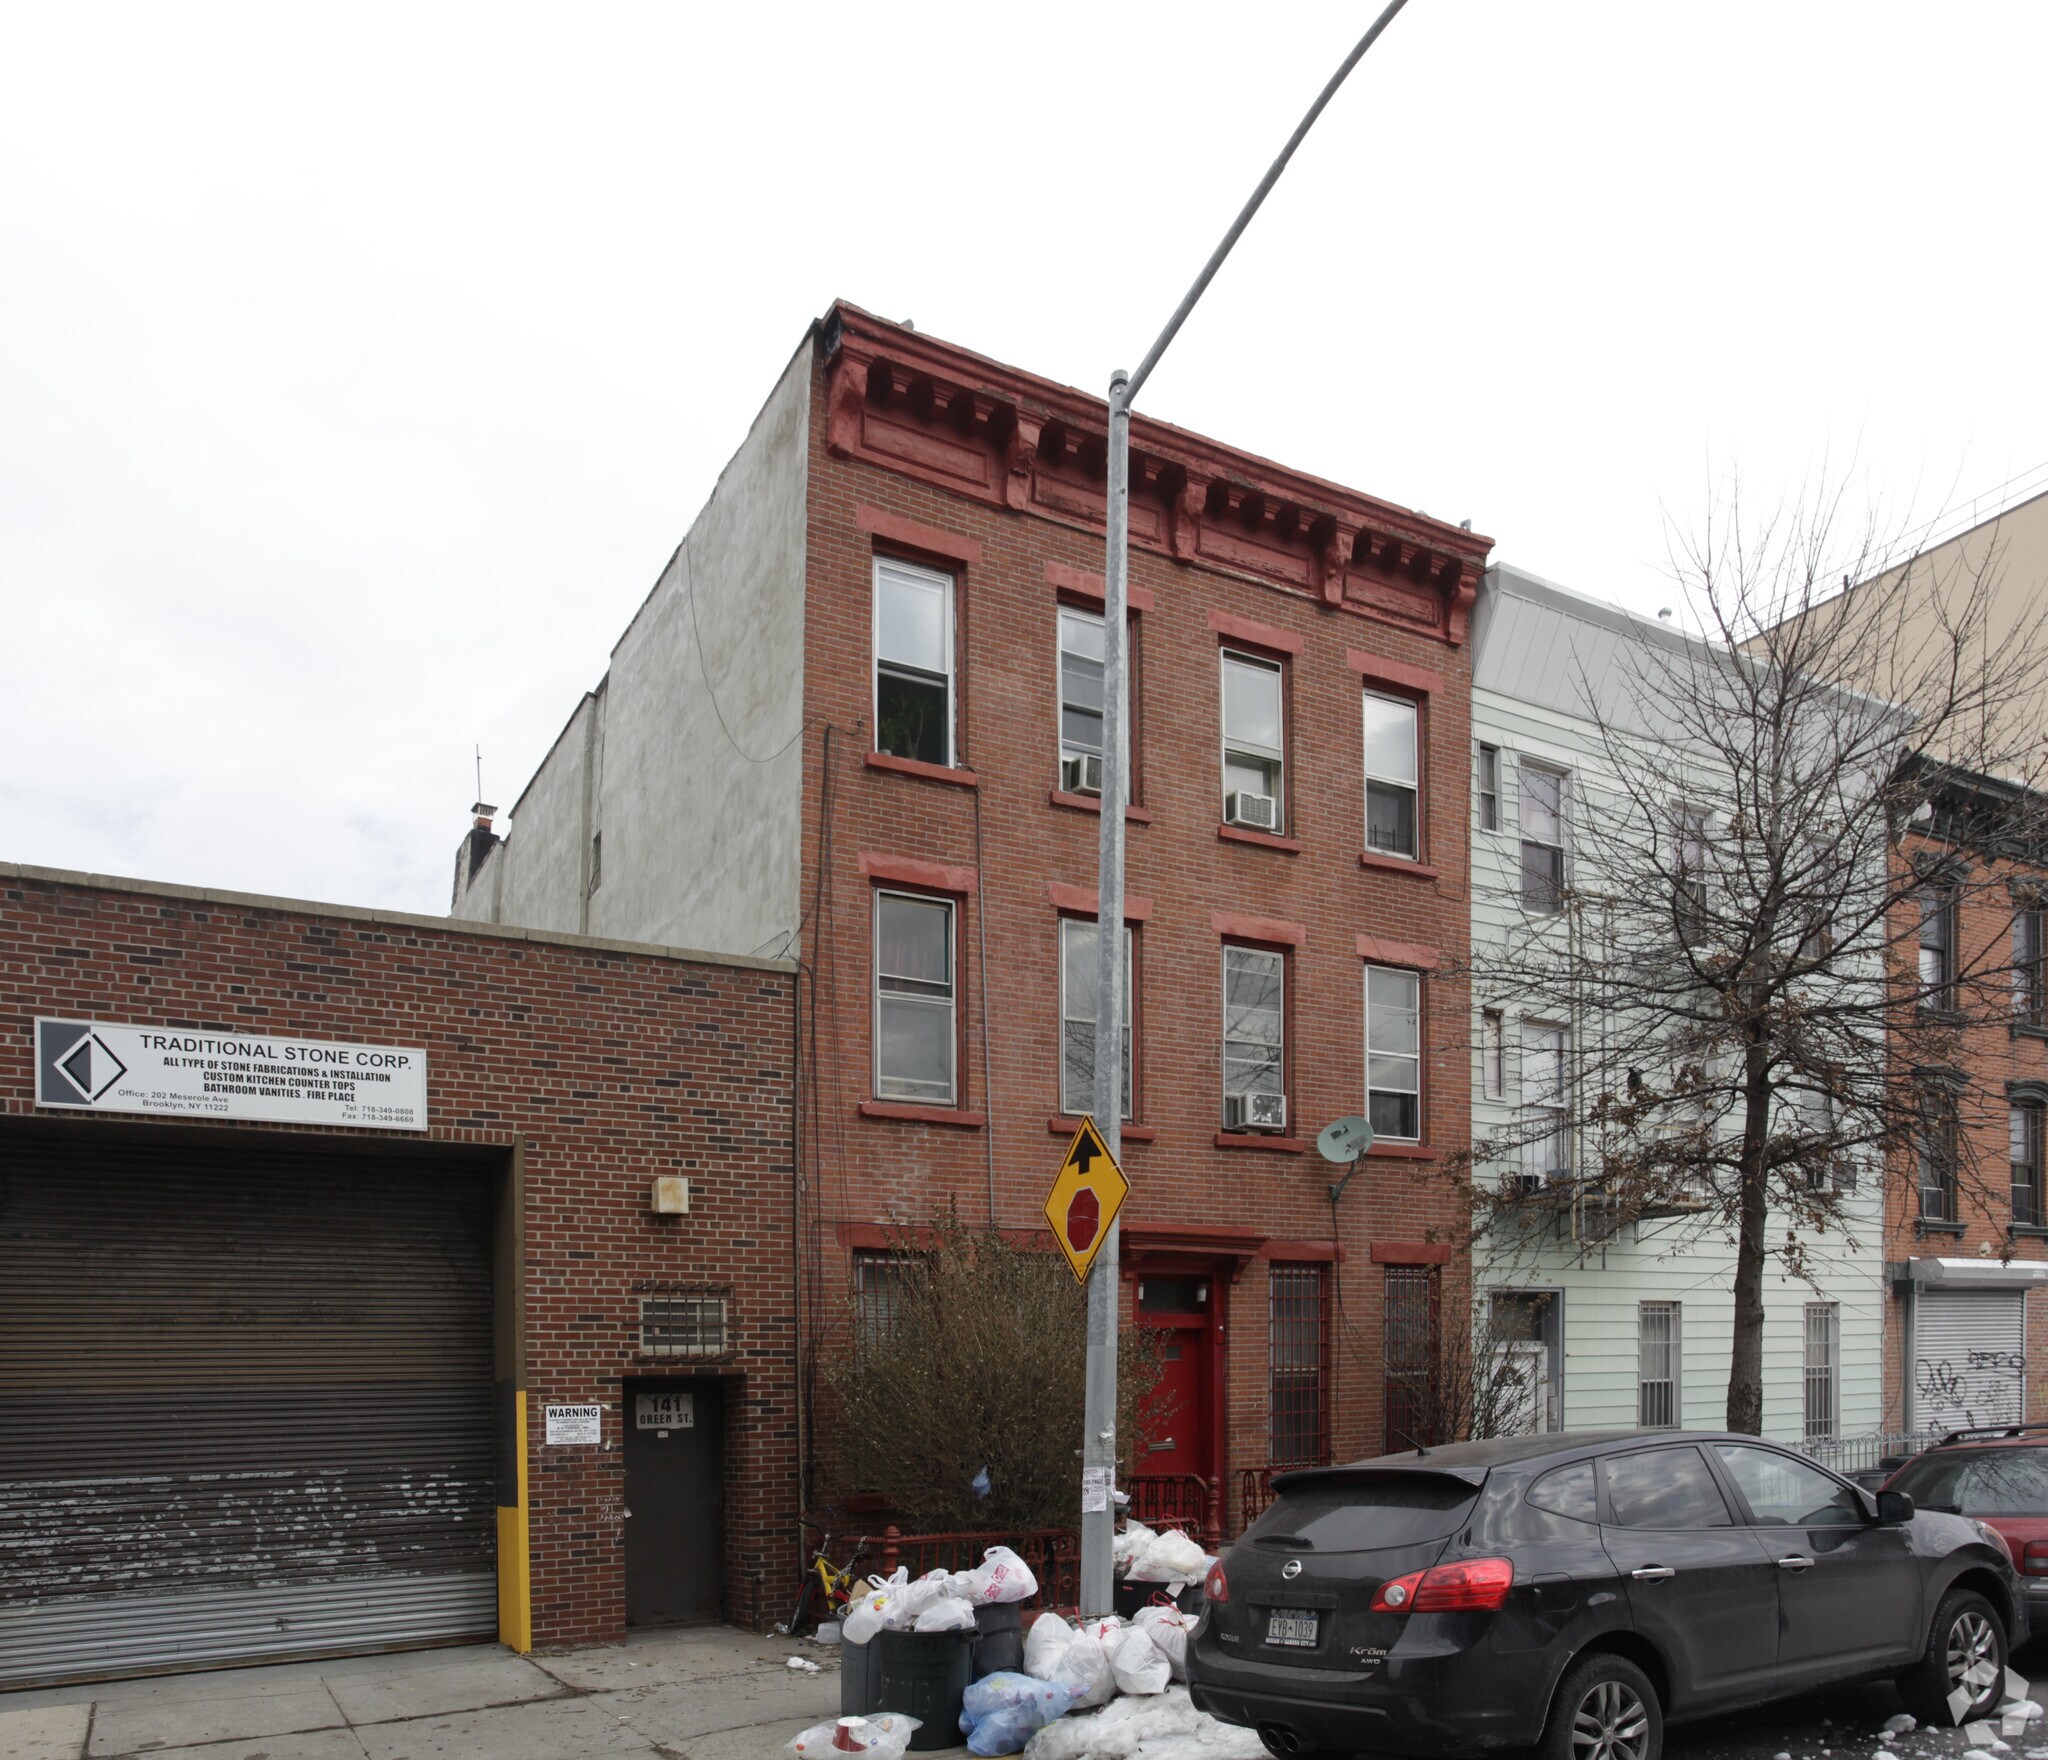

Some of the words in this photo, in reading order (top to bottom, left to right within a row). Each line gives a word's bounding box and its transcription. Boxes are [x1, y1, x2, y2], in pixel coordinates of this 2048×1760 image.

[140, 1035, 278, 1058] TRADITIONAL
[285, 1047, 350, 1064] STONE
[357, 1052, 412, 1070] CORP.
[163, 1057, 180, 1067] ALL
[182, 1058, 205, 1069] TYPE
[207, 1060, 219, 1069] OF
[221, 1061, 251, 1072] STONE
[253, 1064, 319, 1078] FABRICATIONS
[322, 1070, 328, 1078] &
[330, 1070, 391, 1082] INSTALLATION
[203, 1071, 244, 1083] CUSTOM
[246, 1074, 286, 1086] KITCHEN
[288, 1078, 330, 1089] COUNTER
[332, 1081, 355, 1091] TOPS
[118, 1089, 148, 1097] Office:
[151, 1091, 167, 1099] 202
[169, 1093, 210, 1102] Meserole
[212, 1095, 229, 1103] Ave
[204, 1083, 256, 1095] BATHROOM
[259, 1086, 301, 1098] VANITIES
[307, 1090, 326, 1100] FIRE
[328, 1092, 355, 1102] PLACE
[142, 1100, 186, 1110] Brooklyn,
[204, 1104, 229, 1112] 11222
[342, 1112, 360, 1120] Fax:
[651, 1398, 681, 1412] 141
[548, 1407, 598, 1418] WARNING
[640, 1413, 672, 1424] GREEN
[677, 1413, 692, 1424] ST.
